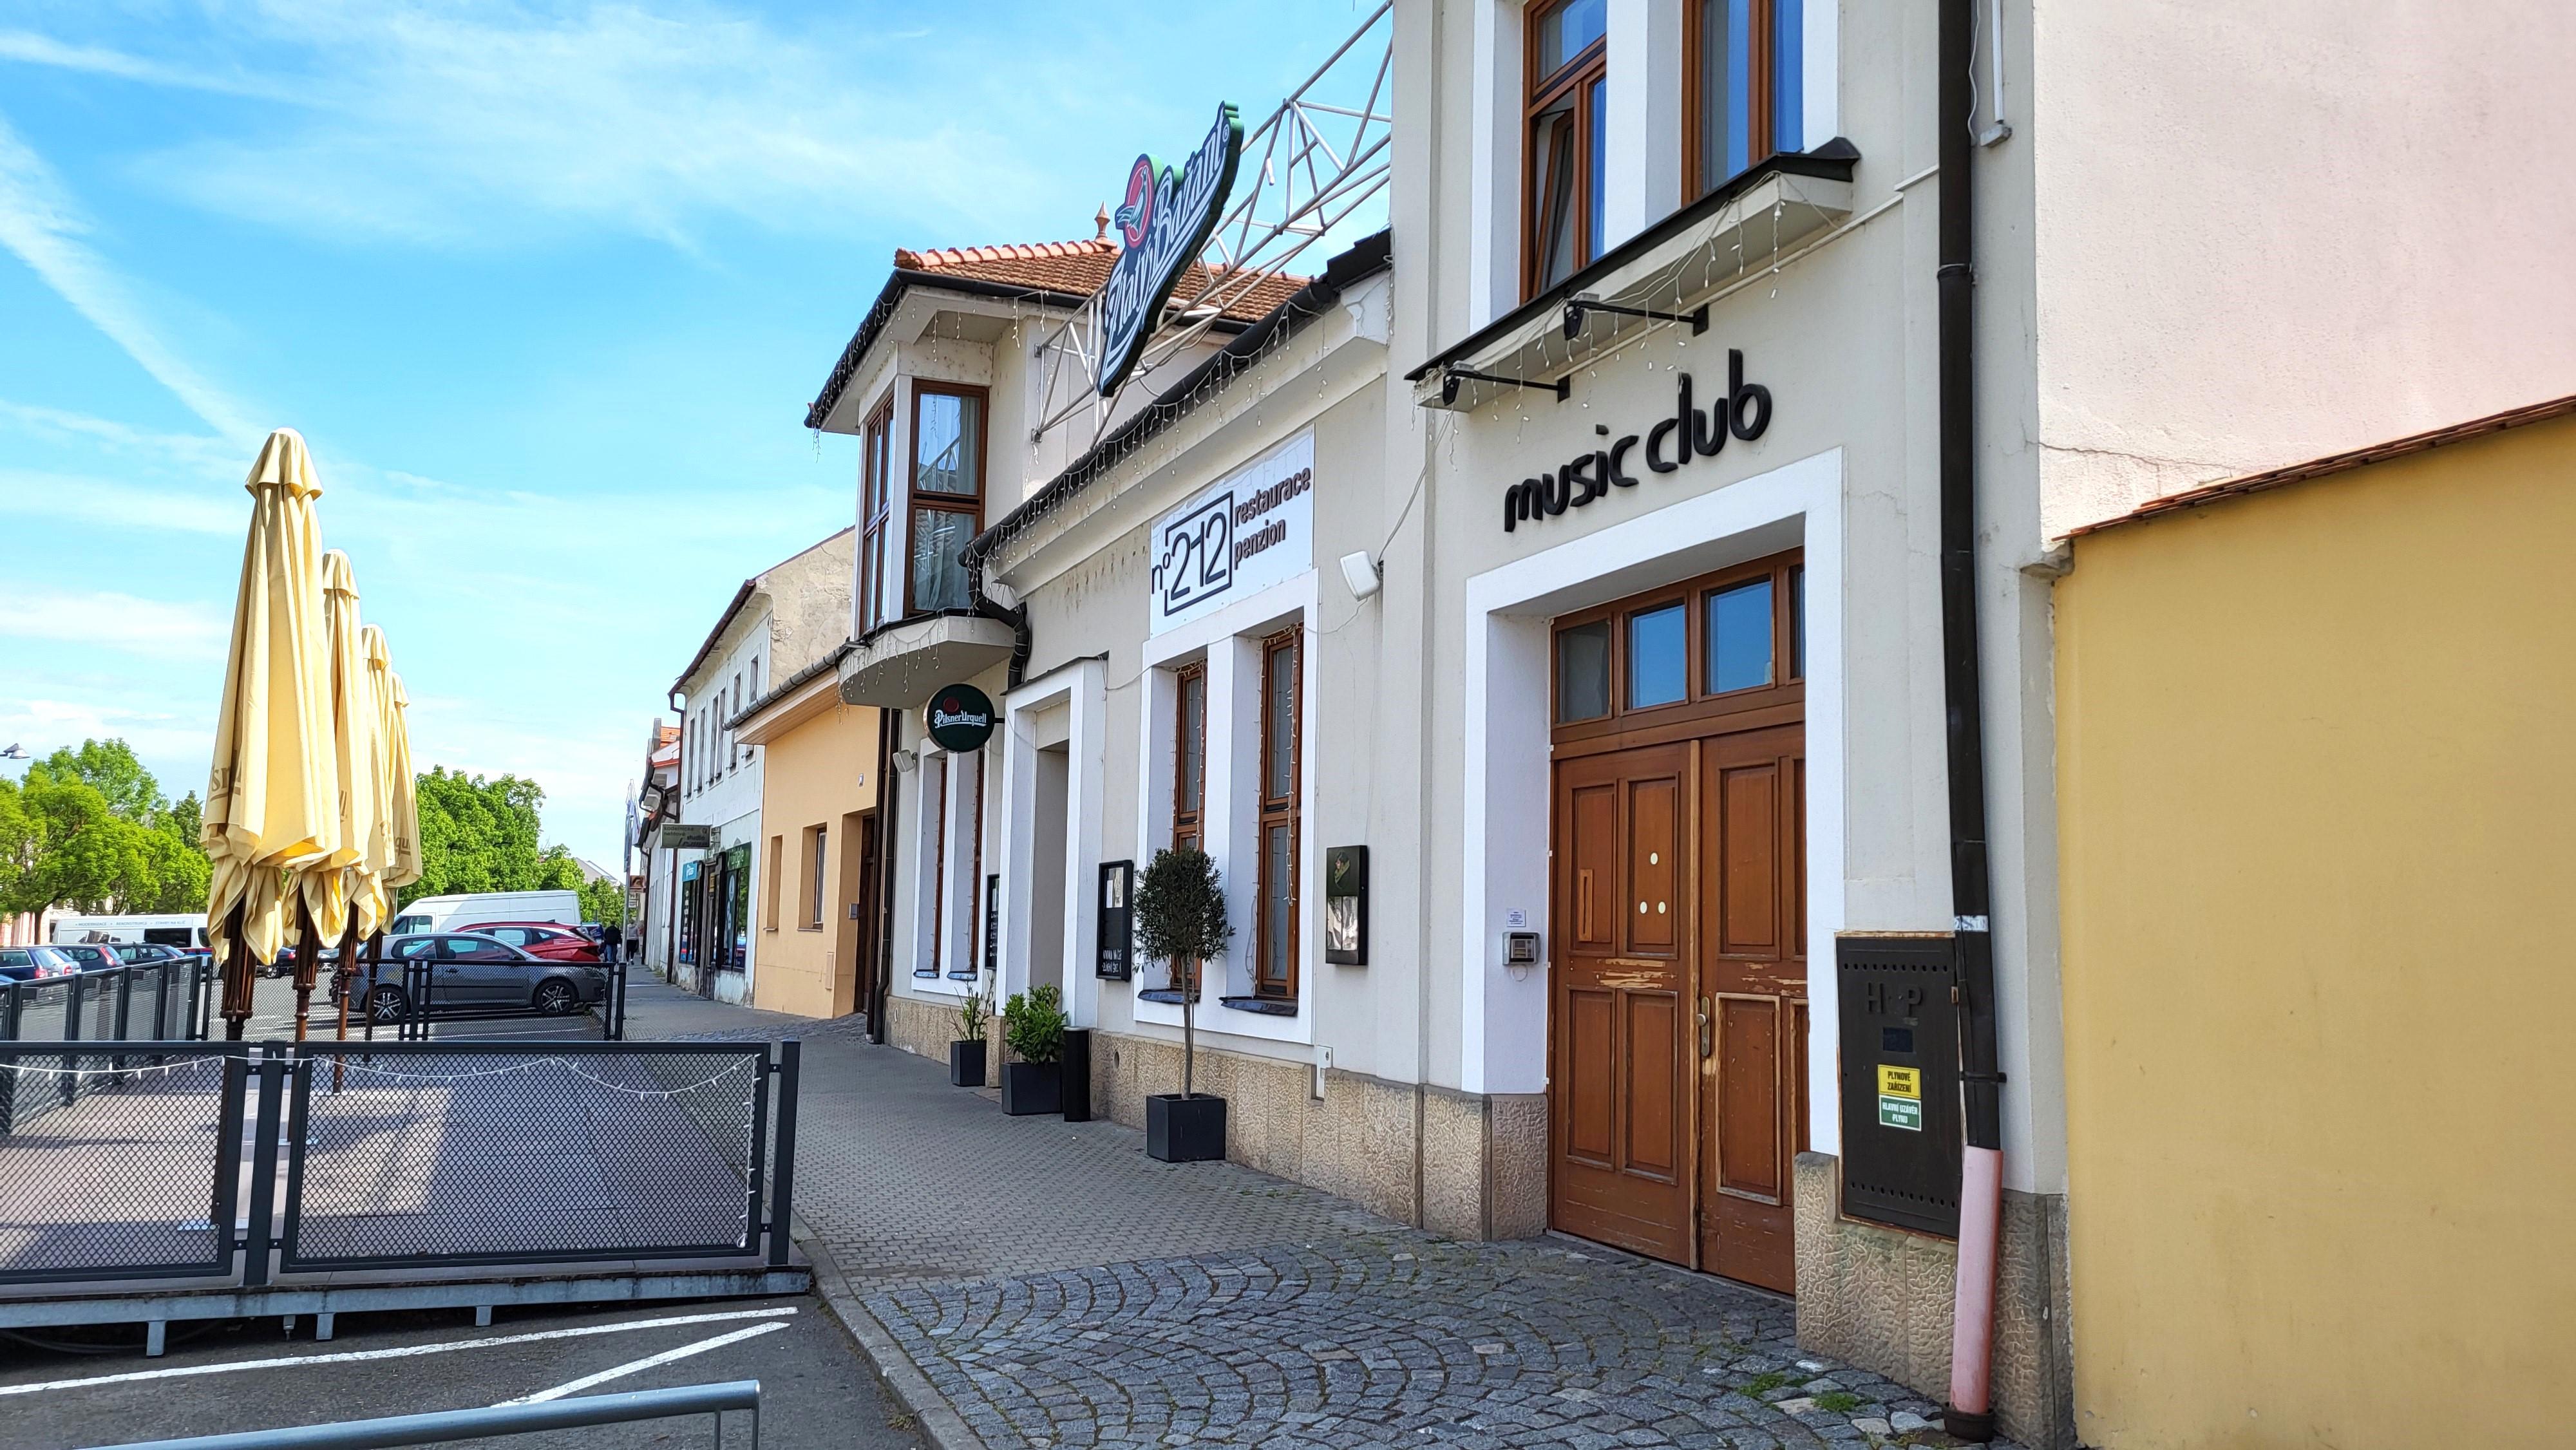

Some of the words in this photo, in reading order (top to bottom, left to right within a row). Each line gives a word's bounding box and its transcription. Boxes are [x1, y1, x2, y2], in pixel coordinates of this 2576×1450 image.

[1504, 424, 1639, 532] music
[1646, 348, 1772, 473] club
[1235, 467, 1311, 527] restaurace
[1234, 519, 1285, 570] penzion
[1171, 513, 1226, 601] 212
[934, 709, 962, 728] Pilsner
[961, 710, 987, 726] Urquell
[1888, 1071, 1911, 1082] PLYNOVÉ
[1887, 1082, 1911, 1093] ZAŘÍZENÍ
[1882, 1102, 1899, 1113] HLAVNÍ
[1899, 1104, 1918, 1115] UZÁVĚR
[1892, 1113, 1908, 1124] PLYNU
